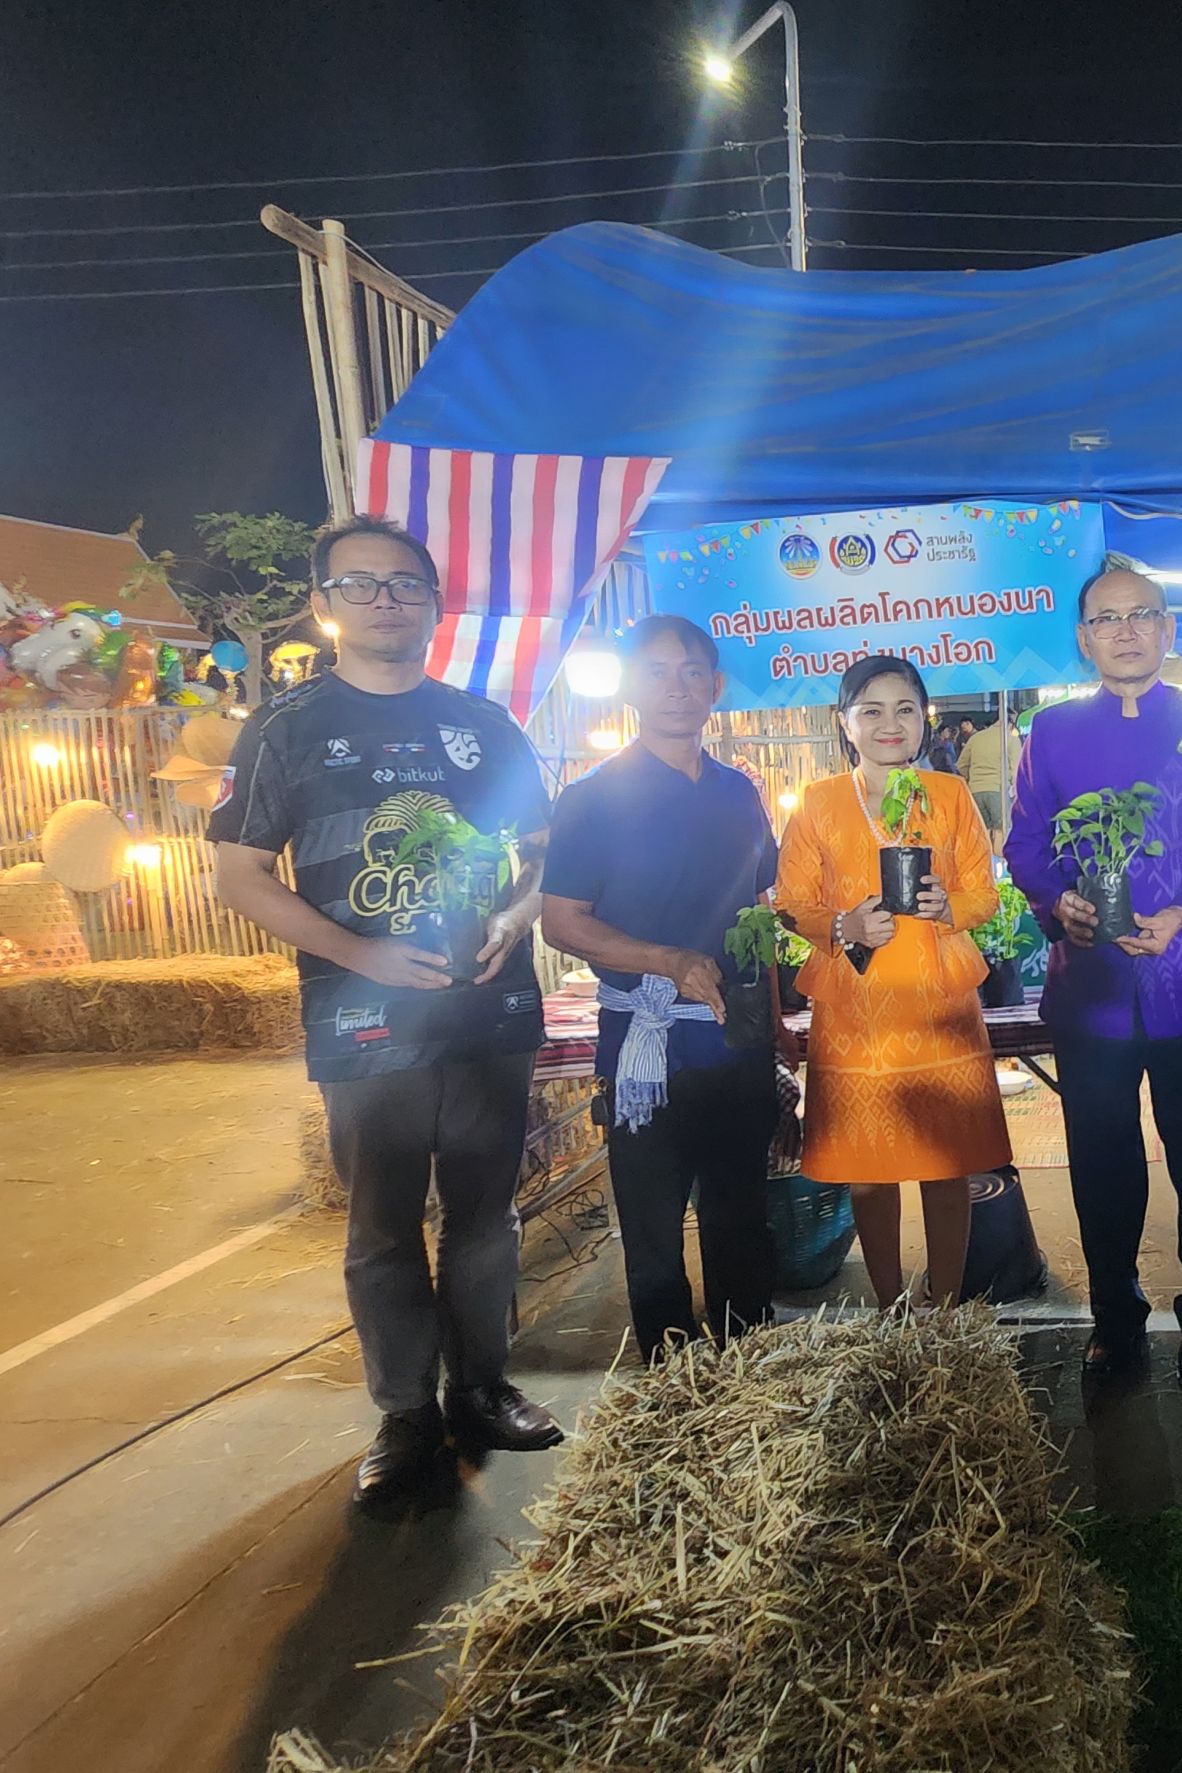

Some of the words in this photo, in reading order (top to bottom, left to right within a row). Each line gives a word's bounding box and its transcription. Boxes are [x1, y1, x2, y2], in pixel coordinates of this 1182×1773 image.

[926, 531, 973, 547] สานพลัง
[926, 545, 977, 563] ประชารัฐ
[709, 585, 1055, 645] กลุ่มผลผลิตโคกหนองนา
[348, 863, 497, 918] Cha
